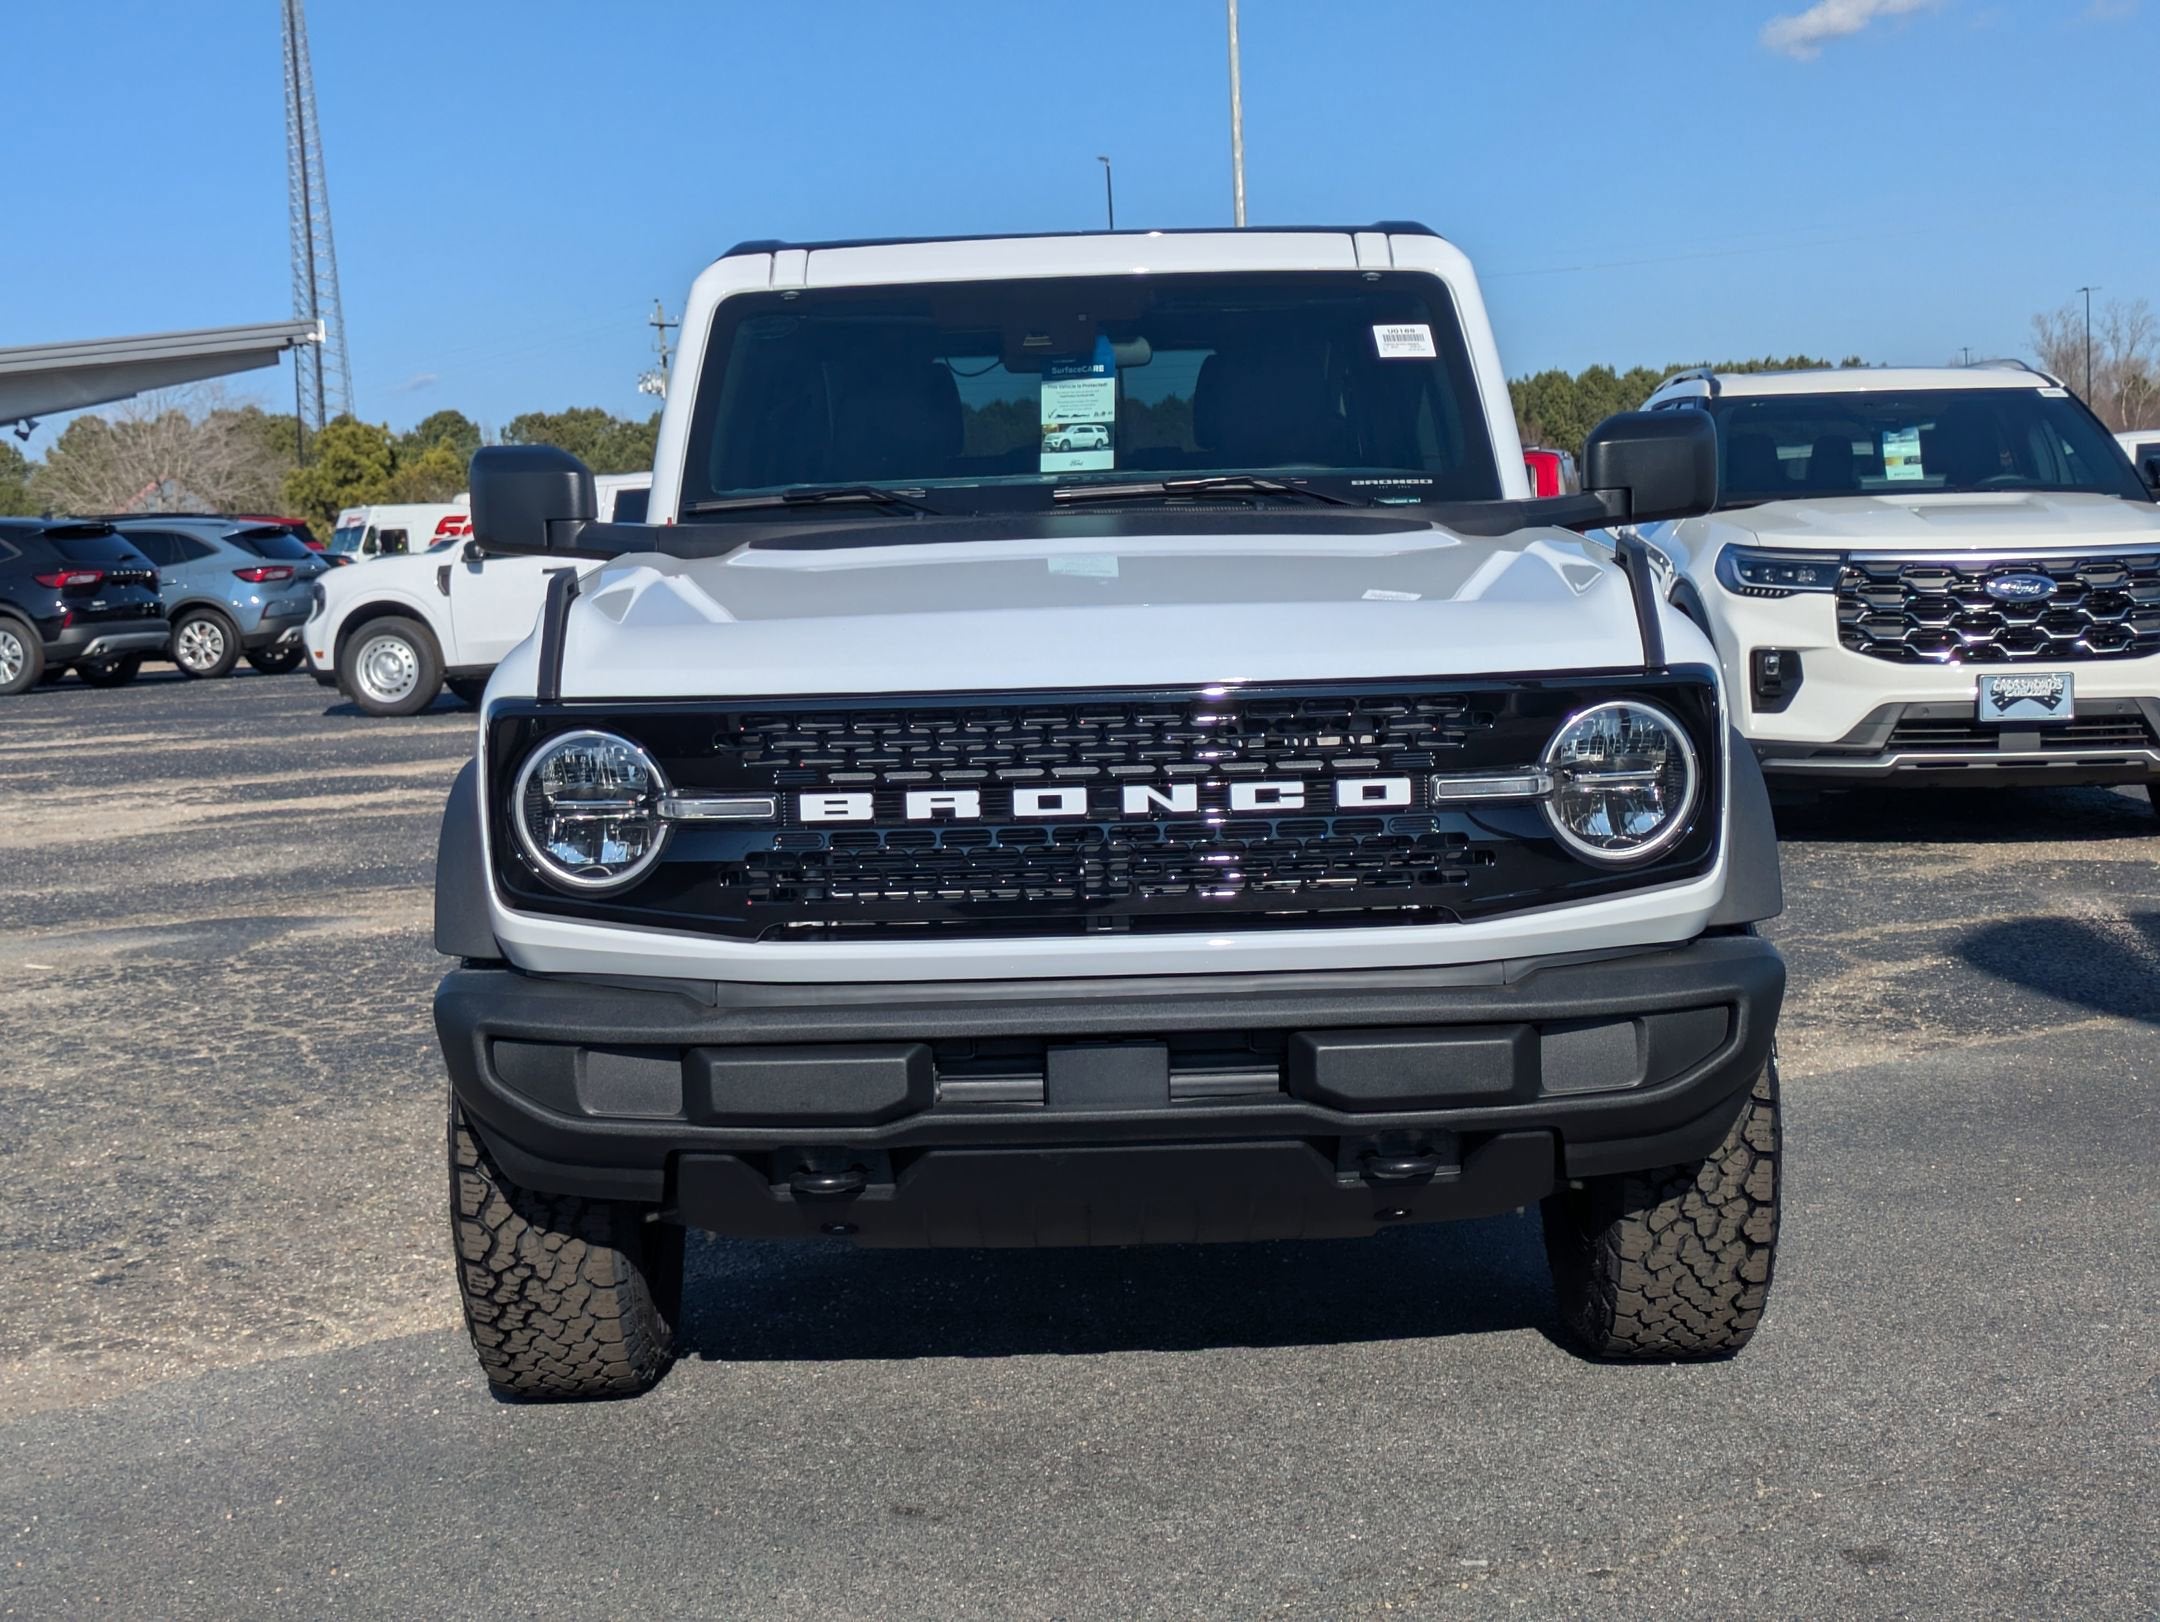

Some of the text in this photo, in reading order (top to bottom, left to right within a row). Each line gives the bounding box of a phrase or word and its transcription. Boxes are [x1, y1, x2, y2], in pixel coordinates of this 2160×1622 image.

[1051, 364, 1105, 374] SurfaceCARE
[1351, 478, 1433, 486] BRONCO
[1991, 677, 2065, 692] CROSSROADS
[799, 777, 1412, 823] BRONCO
